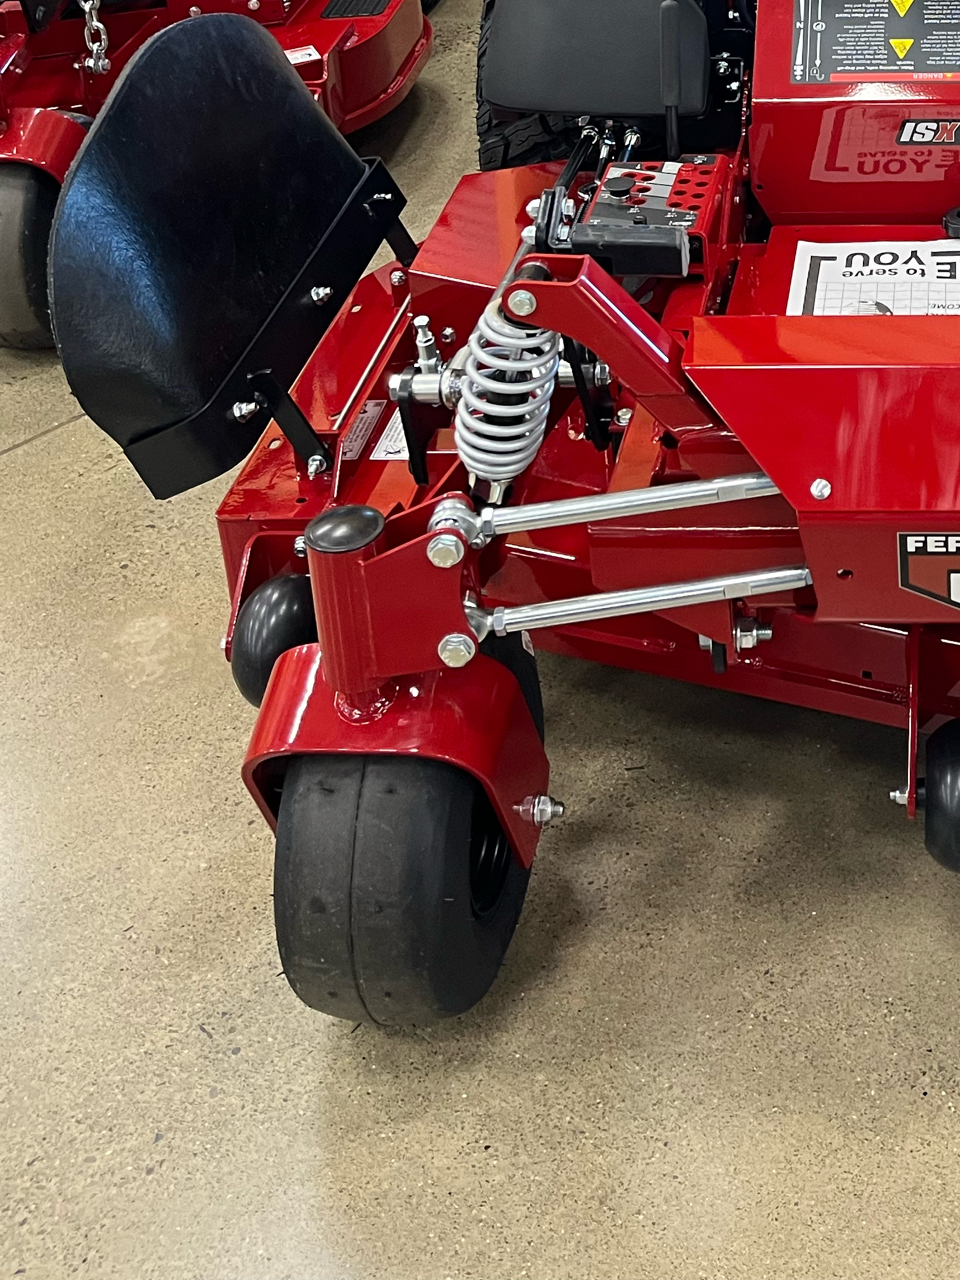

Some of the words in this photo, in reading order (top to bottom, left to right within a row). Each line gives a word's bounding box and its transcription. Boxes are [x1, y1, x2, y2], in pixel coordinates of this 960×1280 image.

[844, 249, 926, 268] YOU
[840, 268, 897, 279] serve
[903, 267, 926, 279] to
